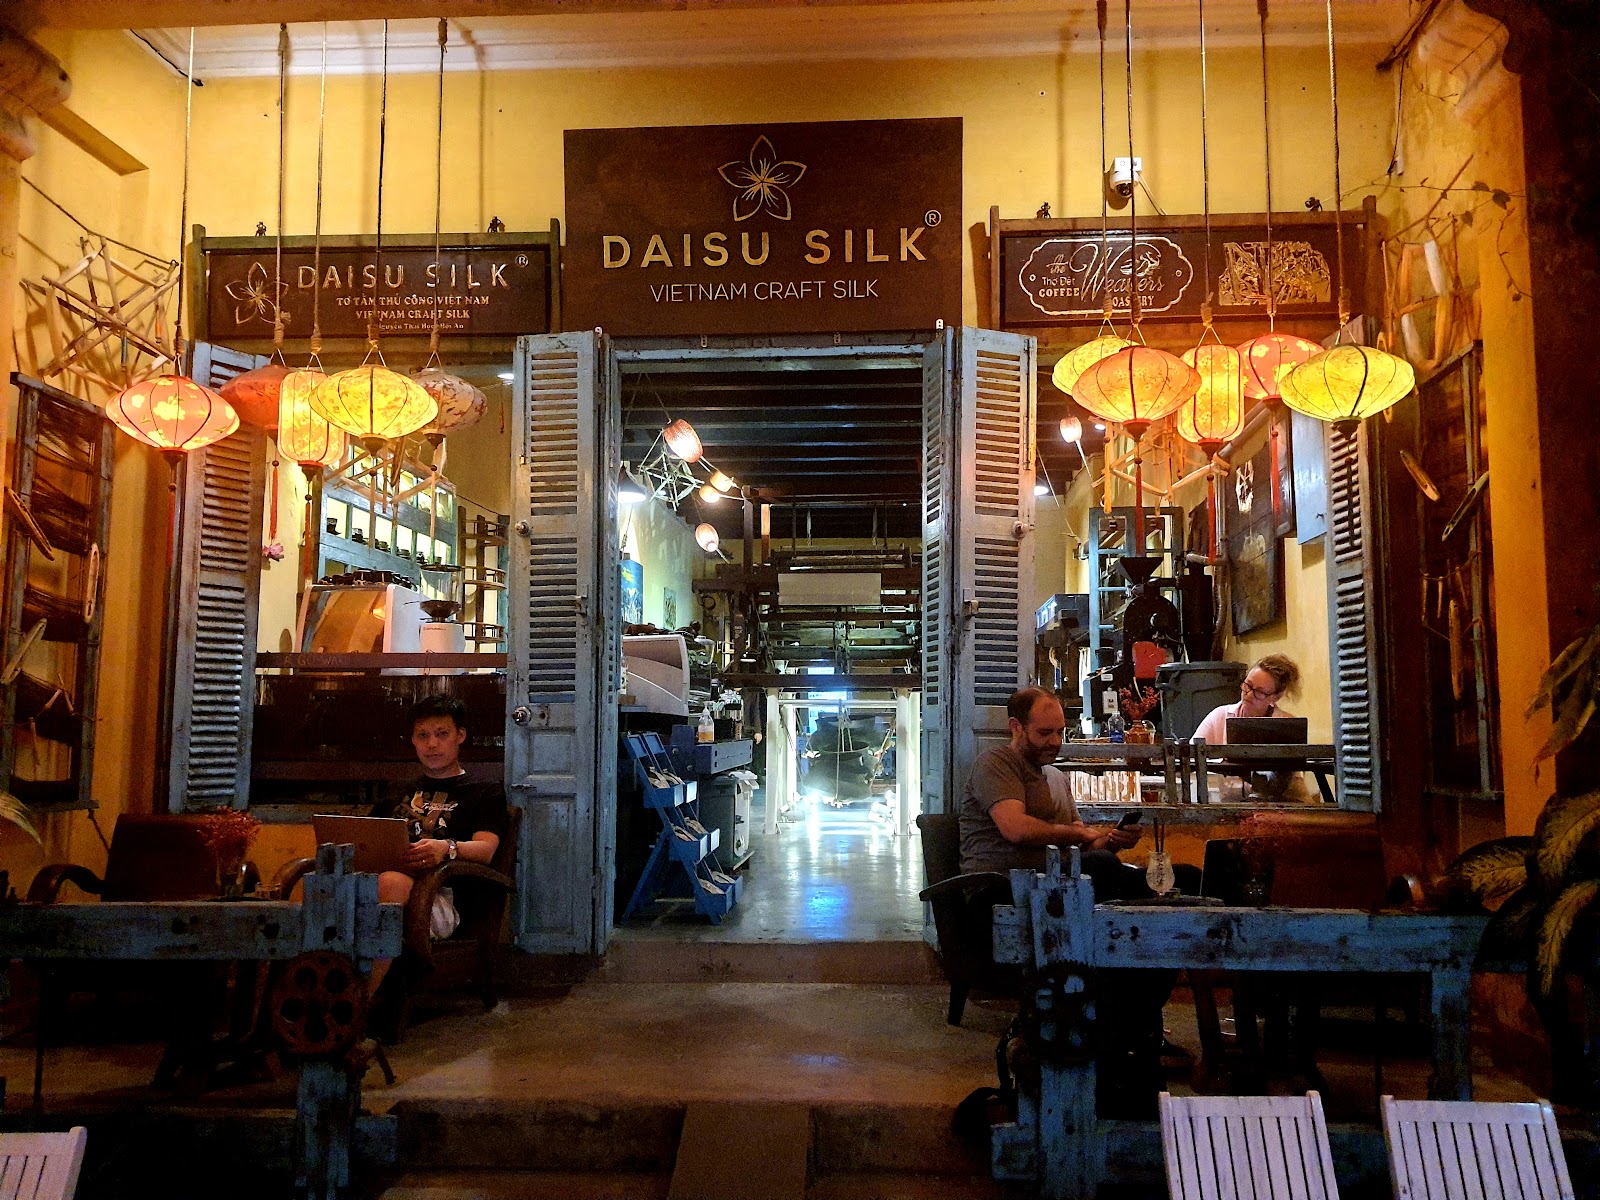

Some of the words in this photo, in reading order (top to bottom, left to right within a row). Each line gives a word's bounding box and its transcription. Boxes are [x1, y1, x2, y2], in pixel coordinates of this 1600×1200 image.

[602, 231, 770, 269] DAISU
[804, 226, 927, 265] SILK
[298, 264, 404, 289] DAISU
[425, 263, 510, 290] SILK
[404, 293, 434, 305] CÔNG
[465, 296, 490, 305] NAM
[650, 282, 747, 302] VIETNAM
[754, 280, 827, 301] CRAFT
[833, 279, 879, 299] SILK
[1038, 287, 1080, 298] COFFEE
[408, 309, 444, 320] CRAFT
[446, 309, 470, 319] SILK
